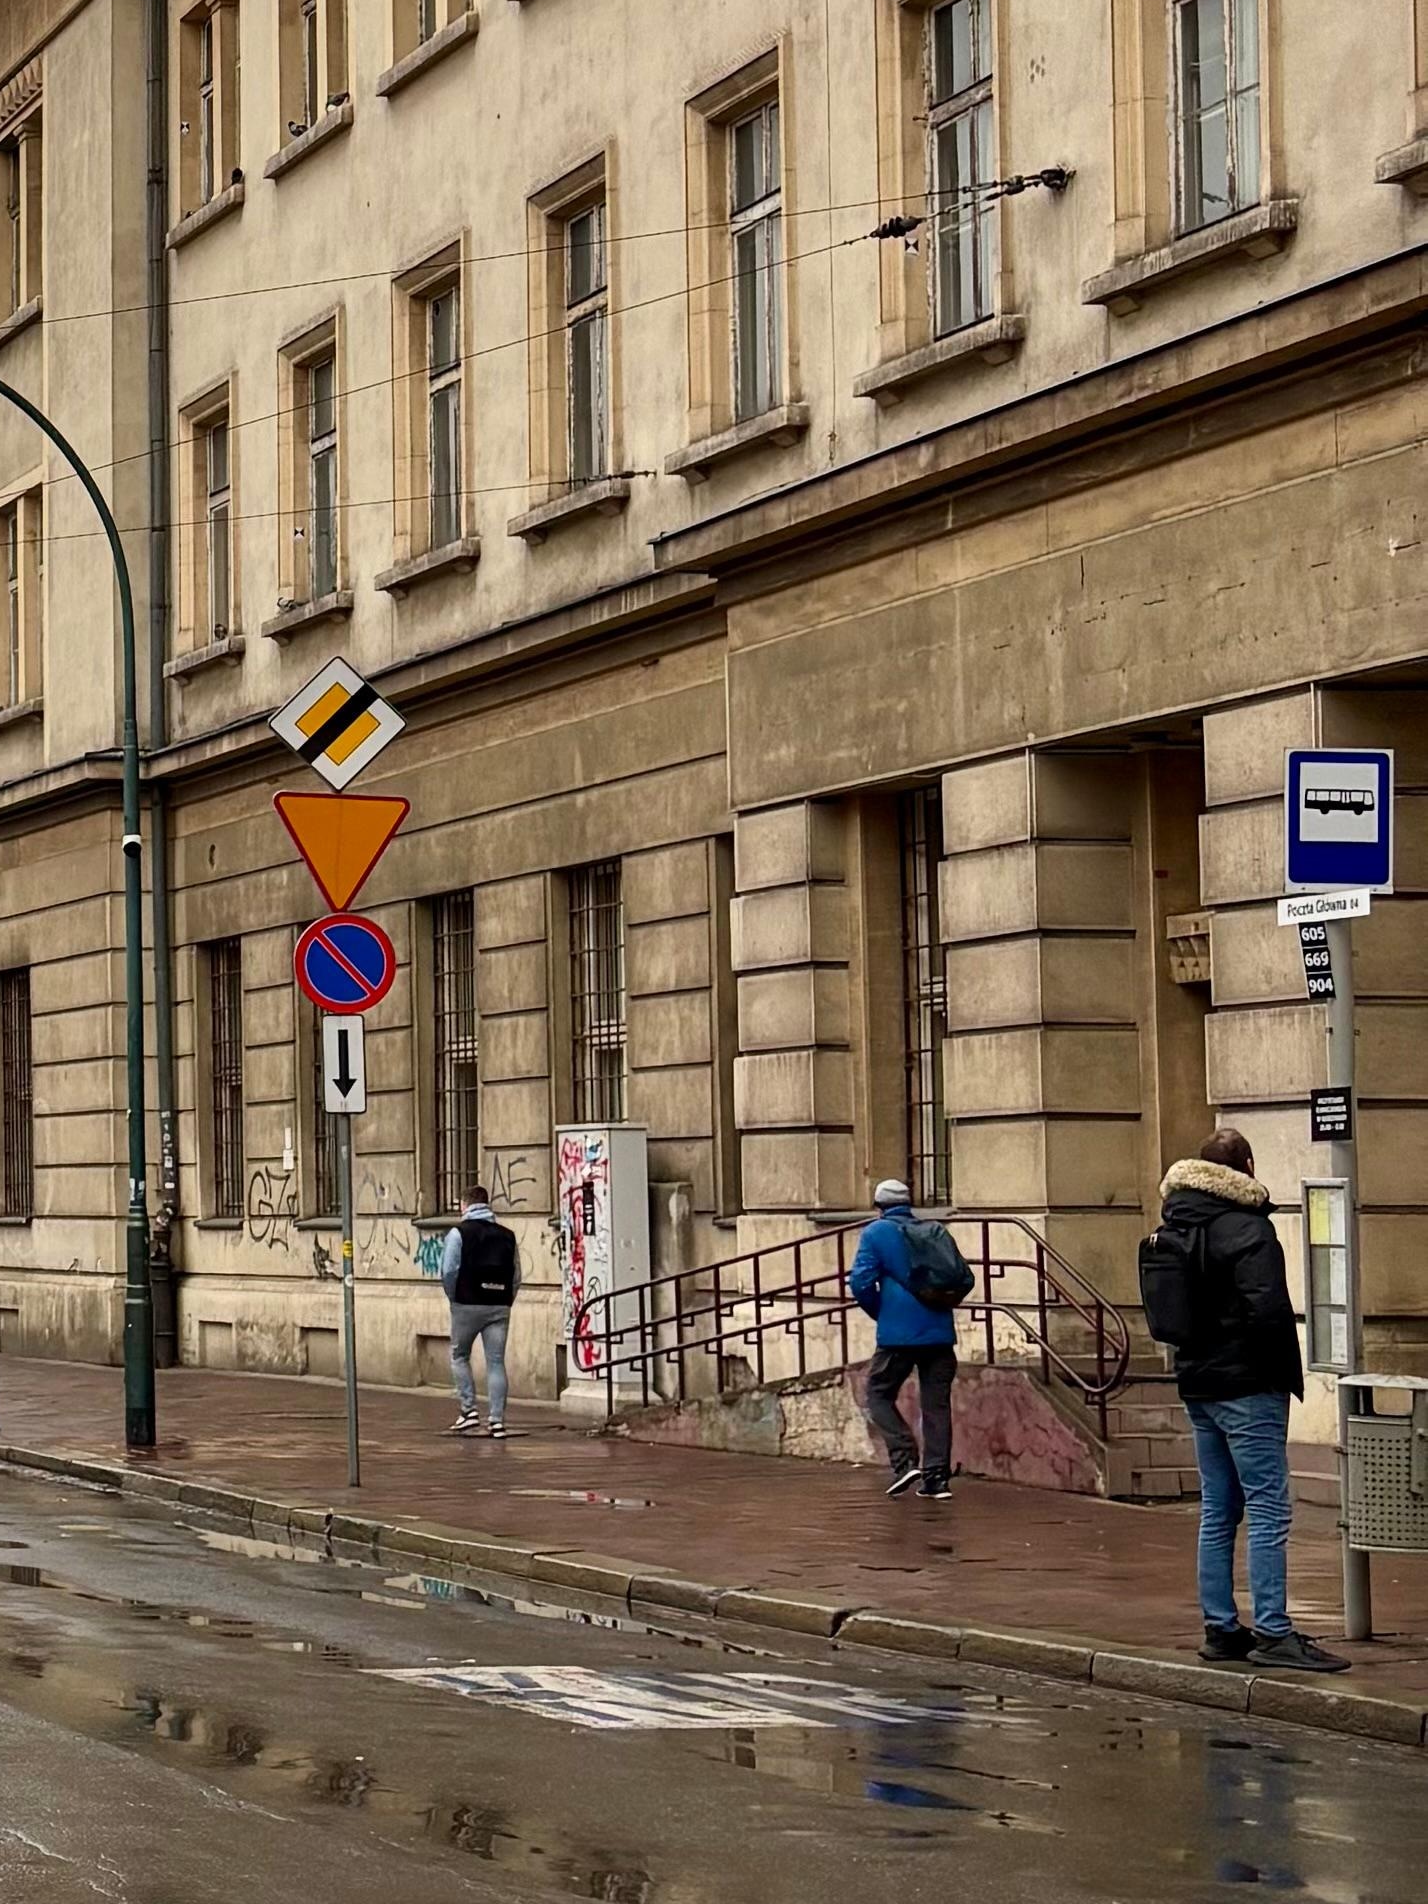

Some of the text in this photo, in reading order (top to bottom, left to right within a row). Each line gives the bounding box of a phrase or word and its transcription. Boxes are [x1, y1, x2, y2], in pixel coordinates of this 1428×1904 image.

[1287, 903, 1314, 917] Poczta
[1301, 926, 1326, 942] 605
[1304, 951, 1329, 967] 669
[1308, 977, 1334, 993] 904
